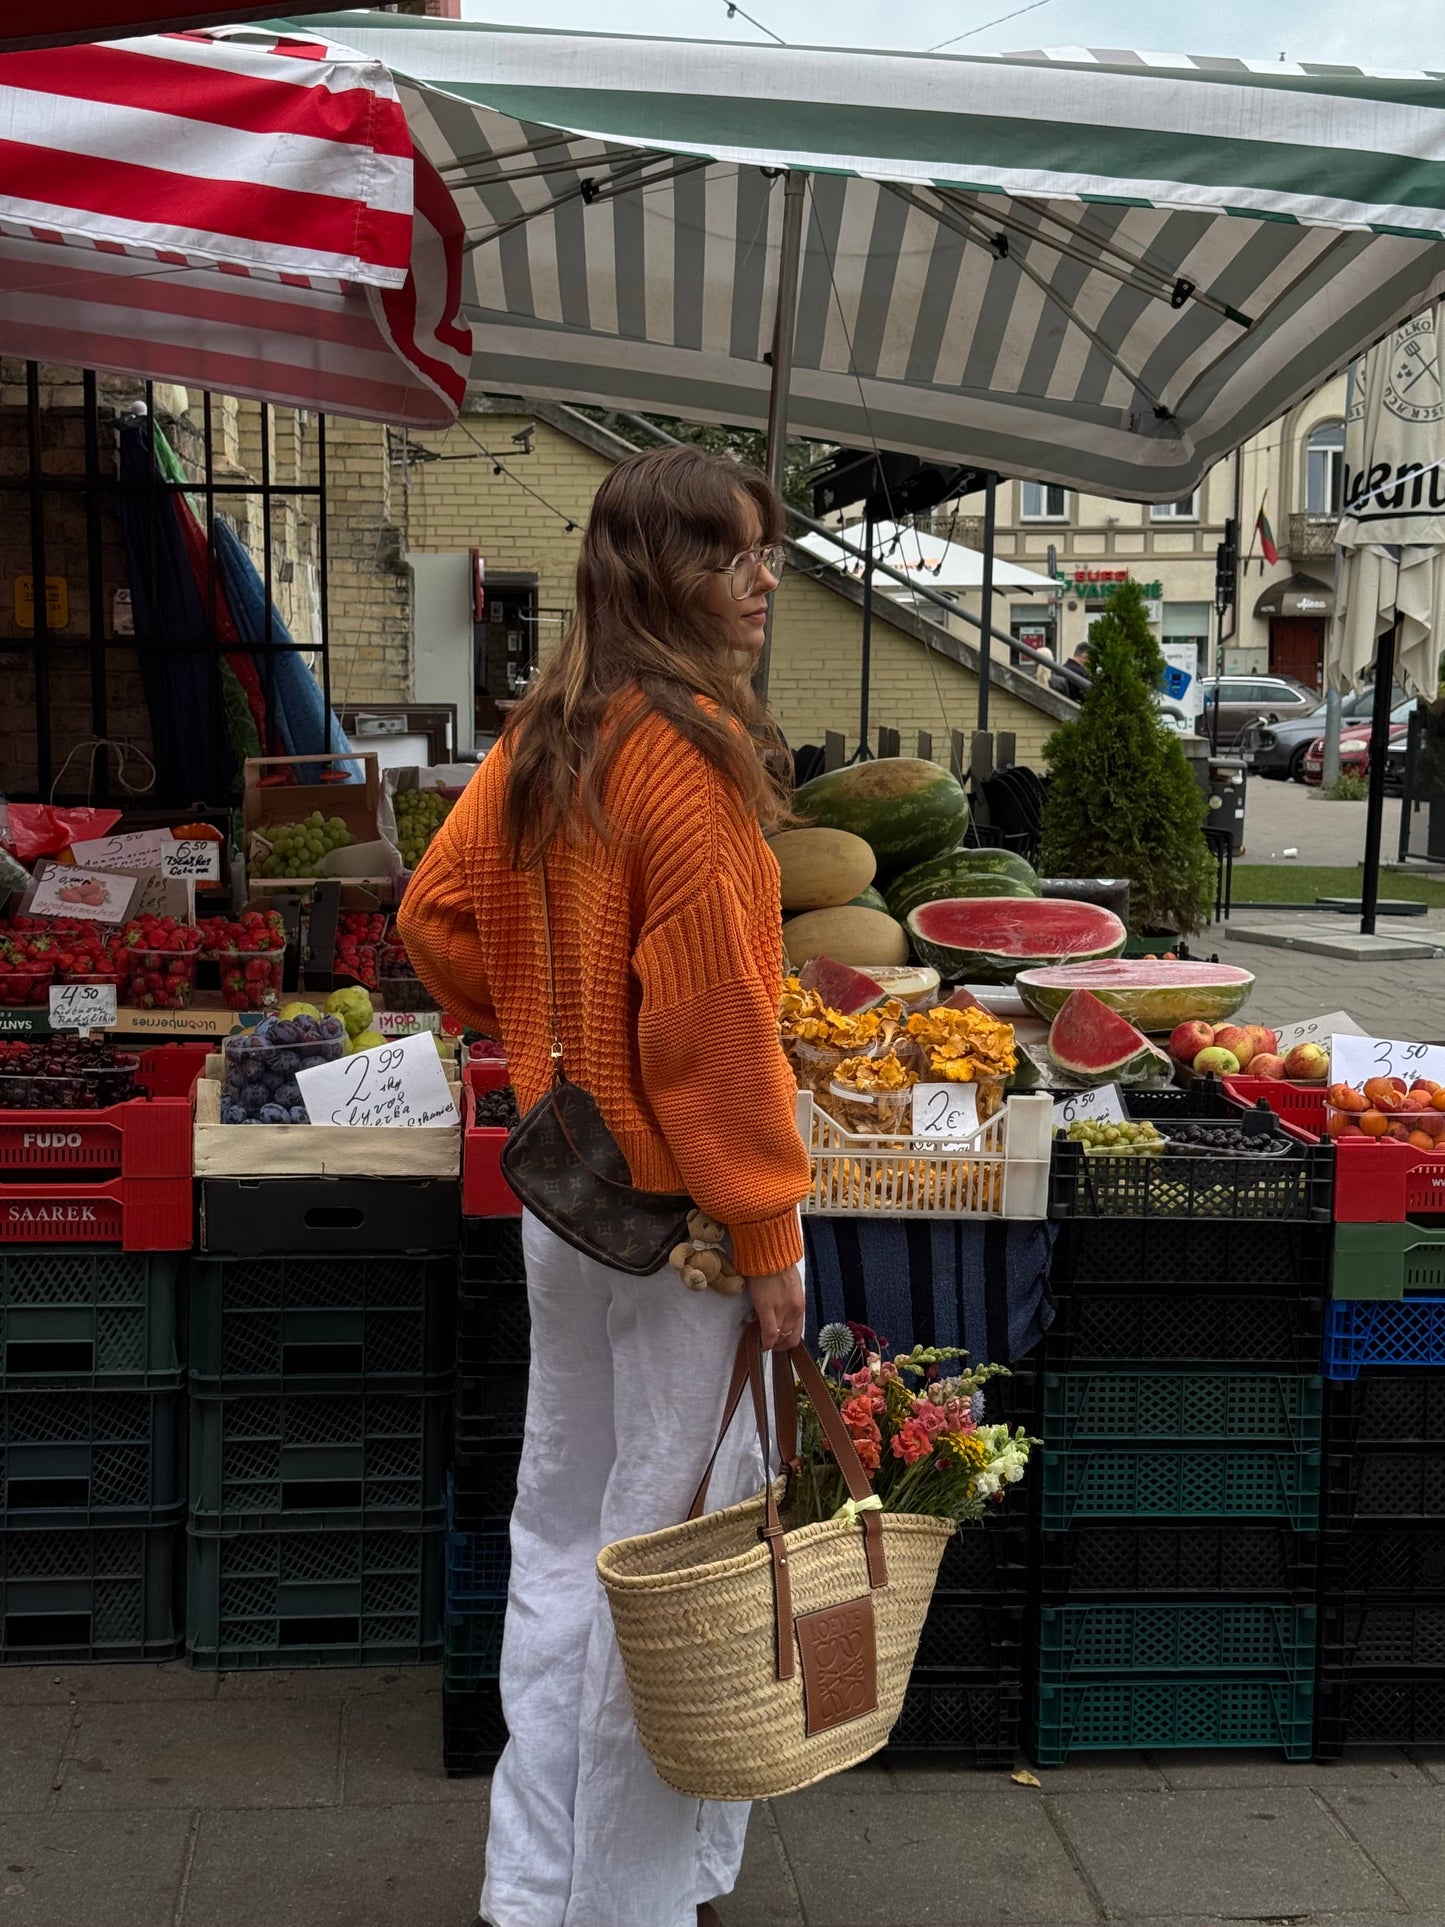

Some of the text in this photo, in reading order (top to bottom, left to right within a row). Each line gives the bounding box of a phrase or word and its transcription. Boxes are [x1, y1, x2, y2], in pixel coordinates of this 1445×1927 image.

[0, 1020, 33, 1030] SANT
[132, 1018, 217, 1030] bloomberries
[23, 1133, 82, 1148] FUDO
[8, 1206, 97, 1221] SAAREK
